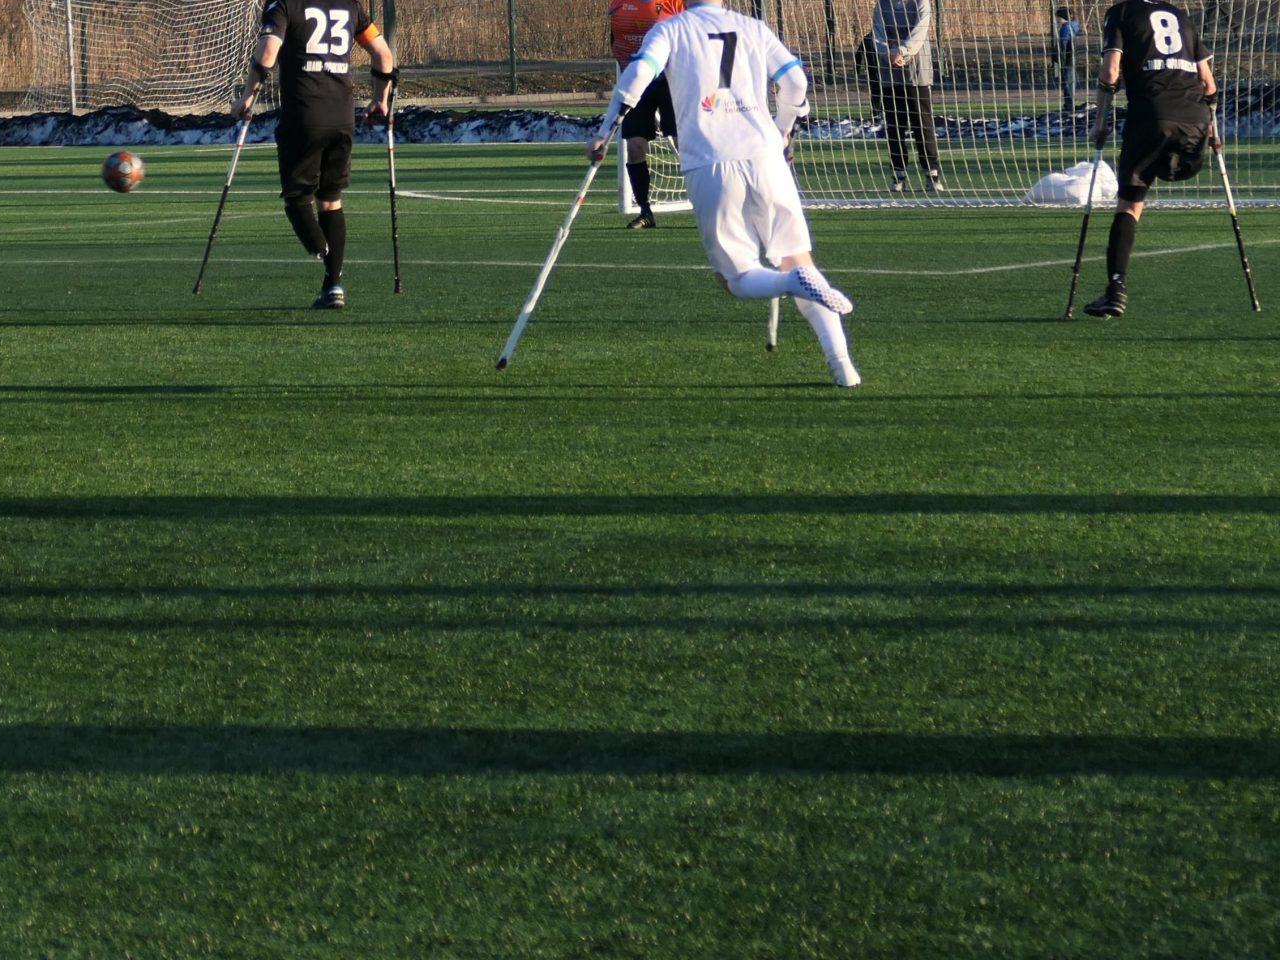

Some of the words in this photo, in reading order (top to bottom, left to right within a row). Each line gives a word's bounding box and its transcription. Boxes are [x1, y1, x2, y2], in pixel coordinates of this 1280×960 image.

[304, 7, 350, 56] 23
[1149, 10, 1183, 55] 8
[707, 31, 738, 89] 7
